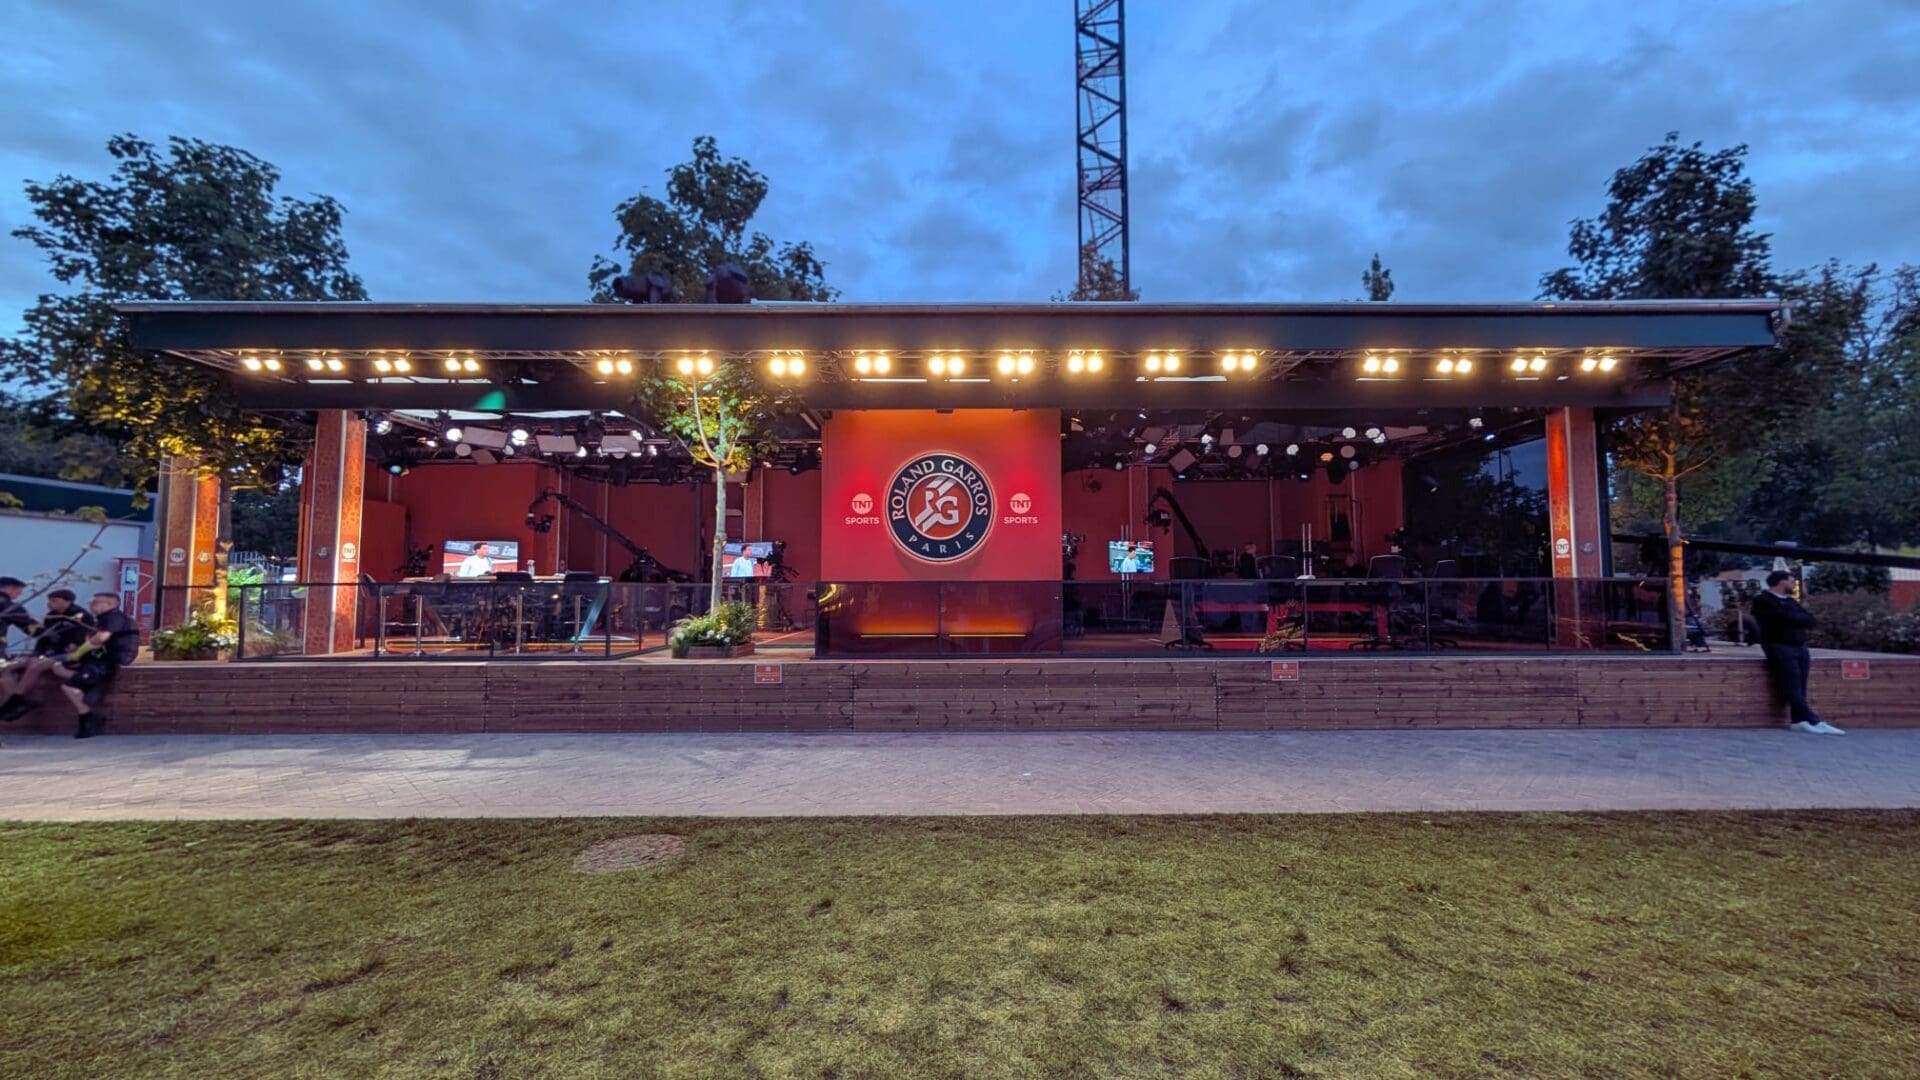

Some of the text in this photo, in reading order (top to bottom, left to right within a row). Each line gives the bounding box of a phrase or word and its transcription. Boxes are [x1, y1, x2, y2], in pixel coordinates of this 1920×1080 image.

[892, 460, 988, 520] ROLAND GARROS
[845, 516, 880, 525] SPORTS
[1003, 516, 1039, 524] SPORTS
[908, 532, 974, 553] PARIS
